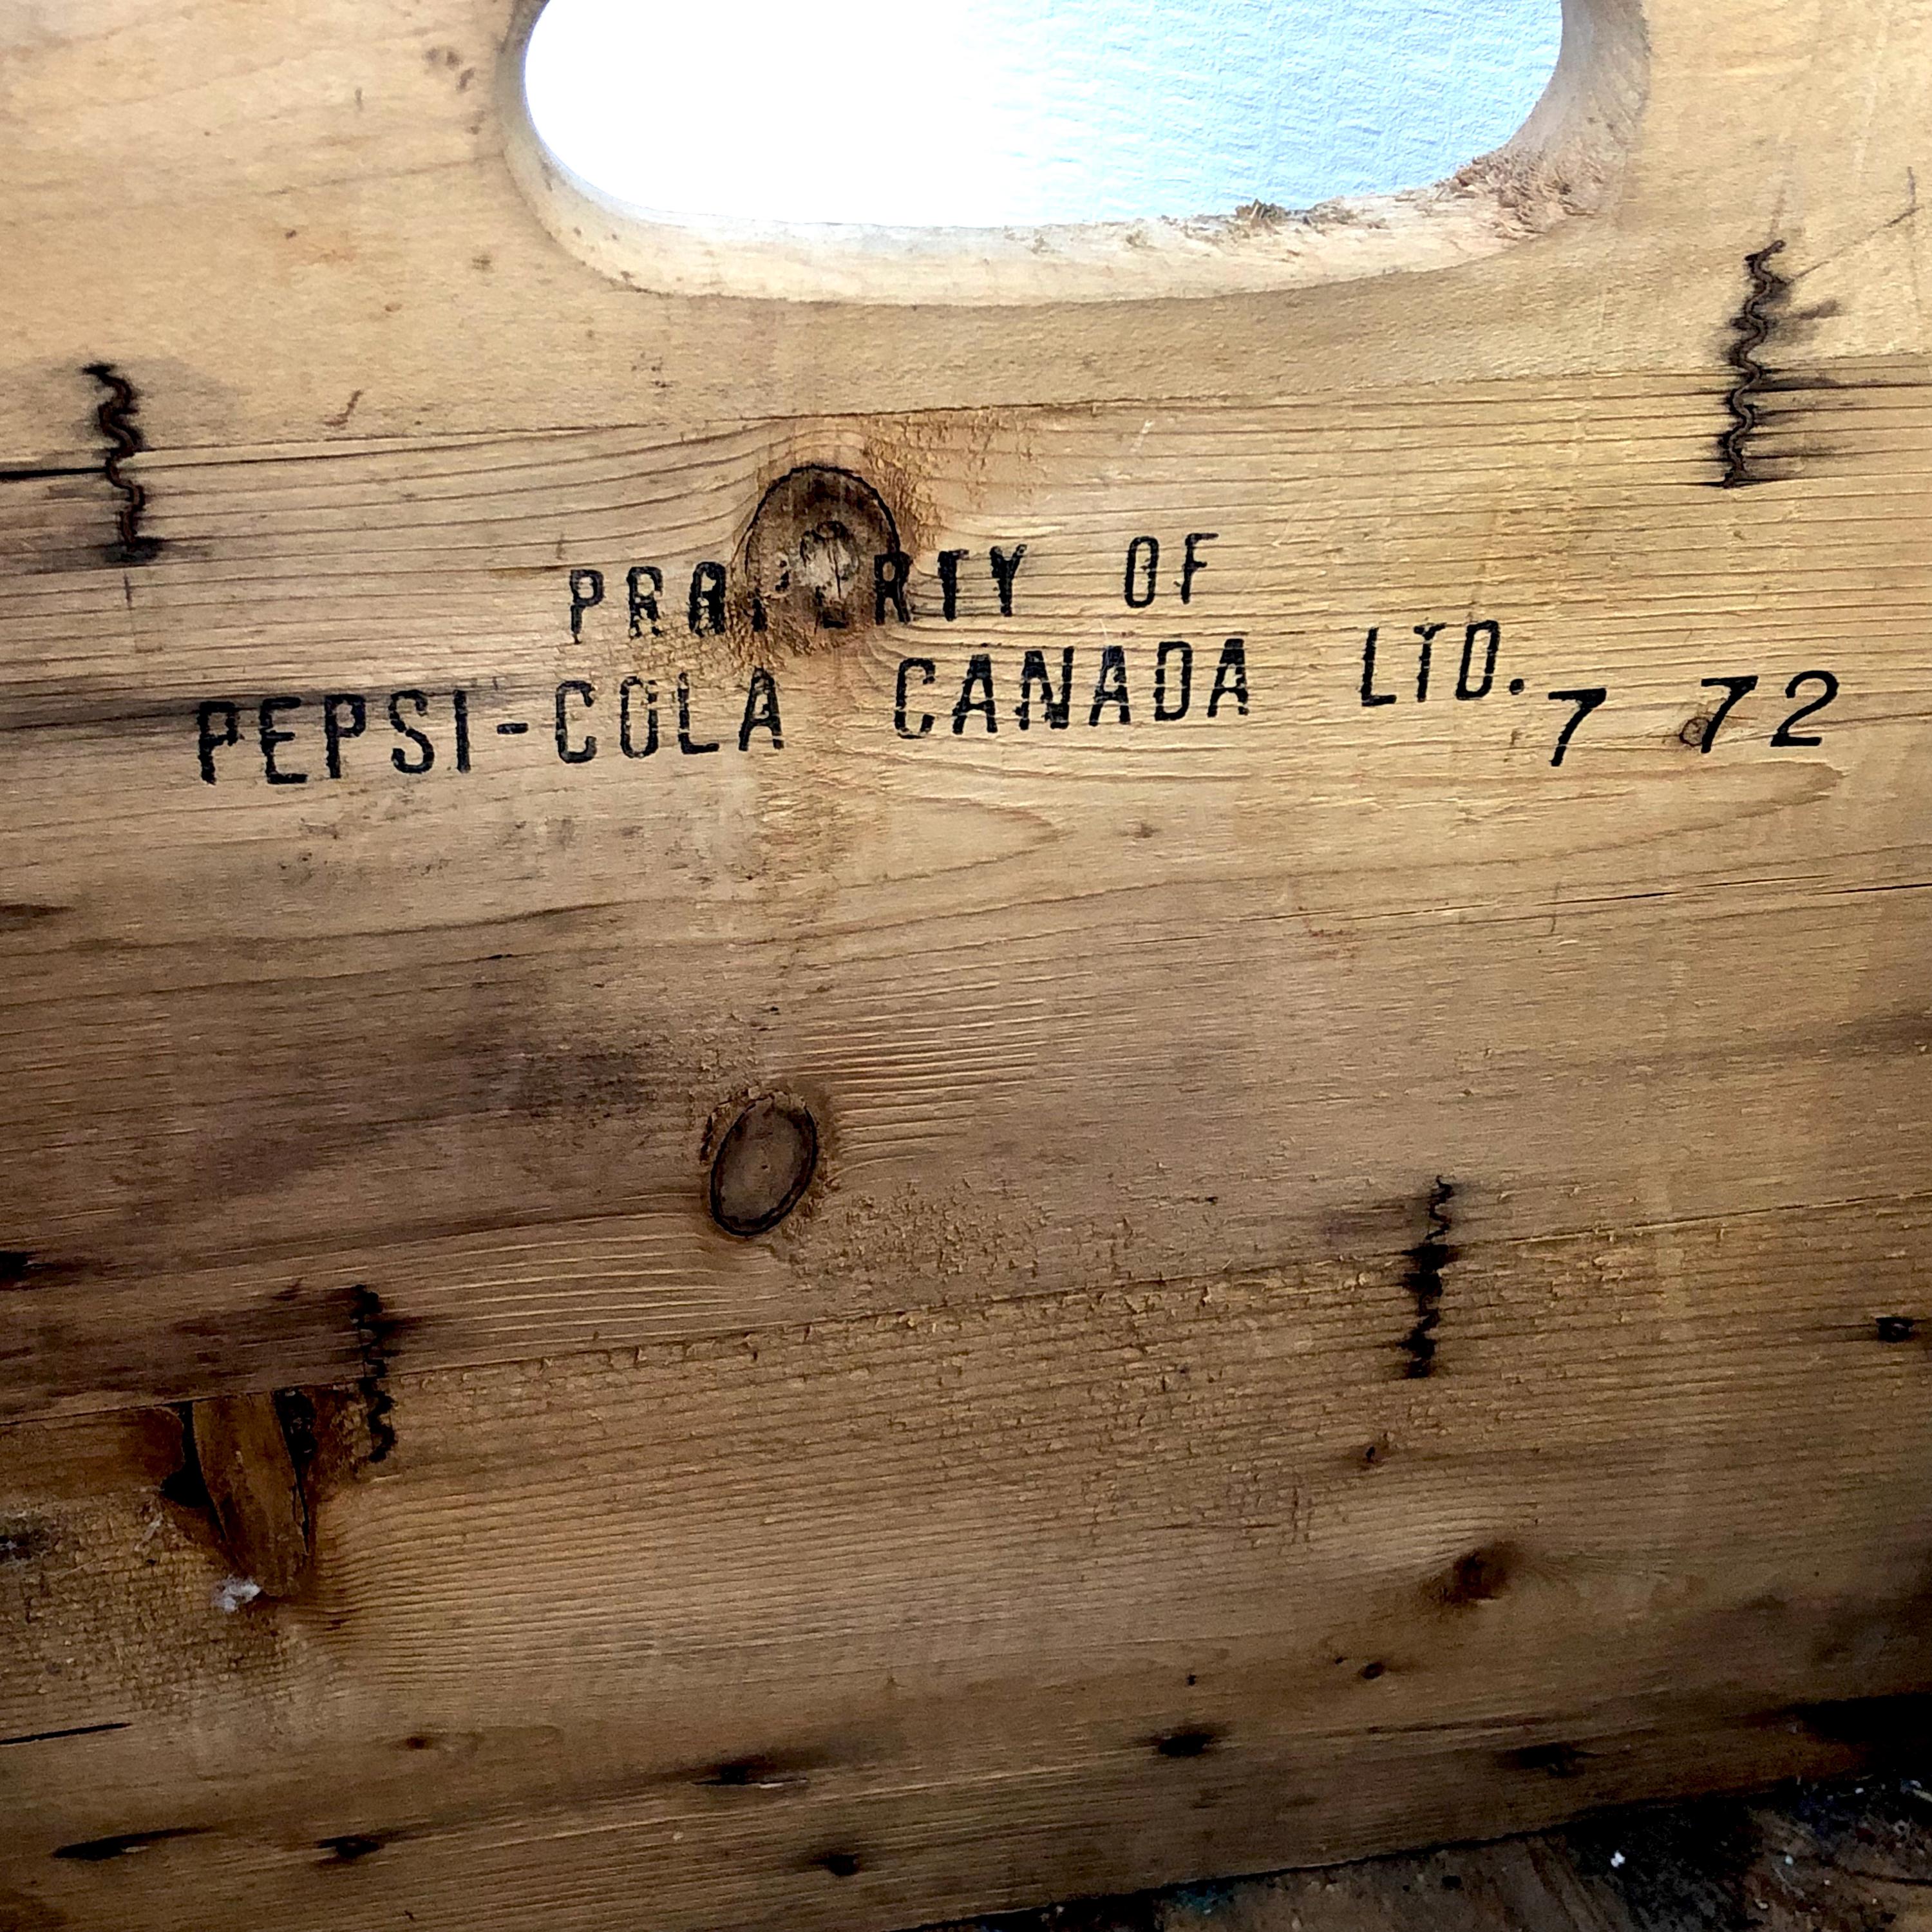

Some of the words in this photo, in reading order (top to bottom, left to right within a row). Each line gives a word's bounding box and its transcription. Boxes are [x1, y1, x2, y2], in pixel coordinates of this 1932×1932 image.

[1124, 532, 1219, 609] OF
[196, 666, 785, 784] PEPSI-COLA
[895, 638, 1250, 739] CANADA
[1360, 620, 1525, 707] LTD.
[1548, 688, 1607, 767] 7
[1701, 670, 1840, 754] 72
